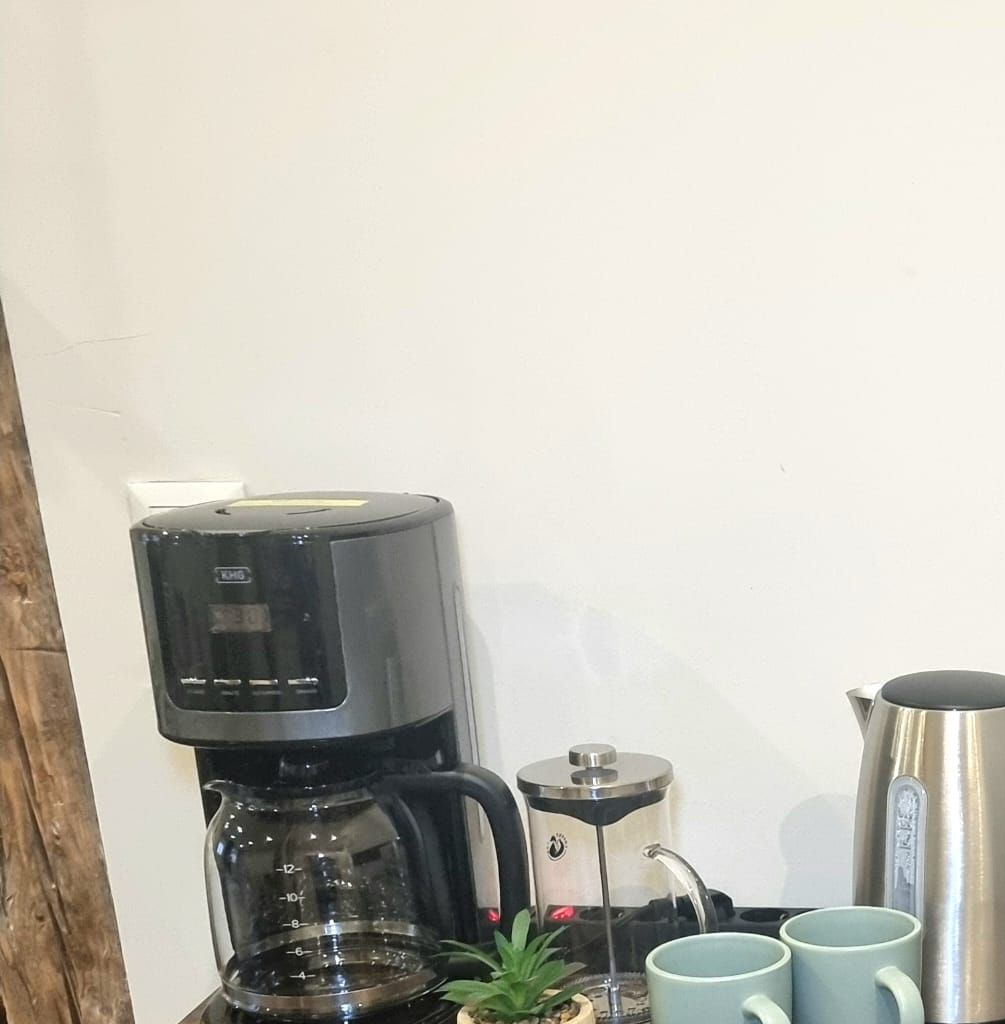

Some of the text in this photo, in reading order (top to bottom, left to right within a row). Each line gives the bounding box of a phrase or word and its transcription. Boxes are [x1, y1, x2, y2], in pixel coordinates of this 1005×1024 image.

[283, 864, 295, 874] 12
[286, 893, 298, 902] 10
[291, 920, 299, 928] 8
[295, 947, 304, 956] 6
[299, 971, 306, 980] 4
